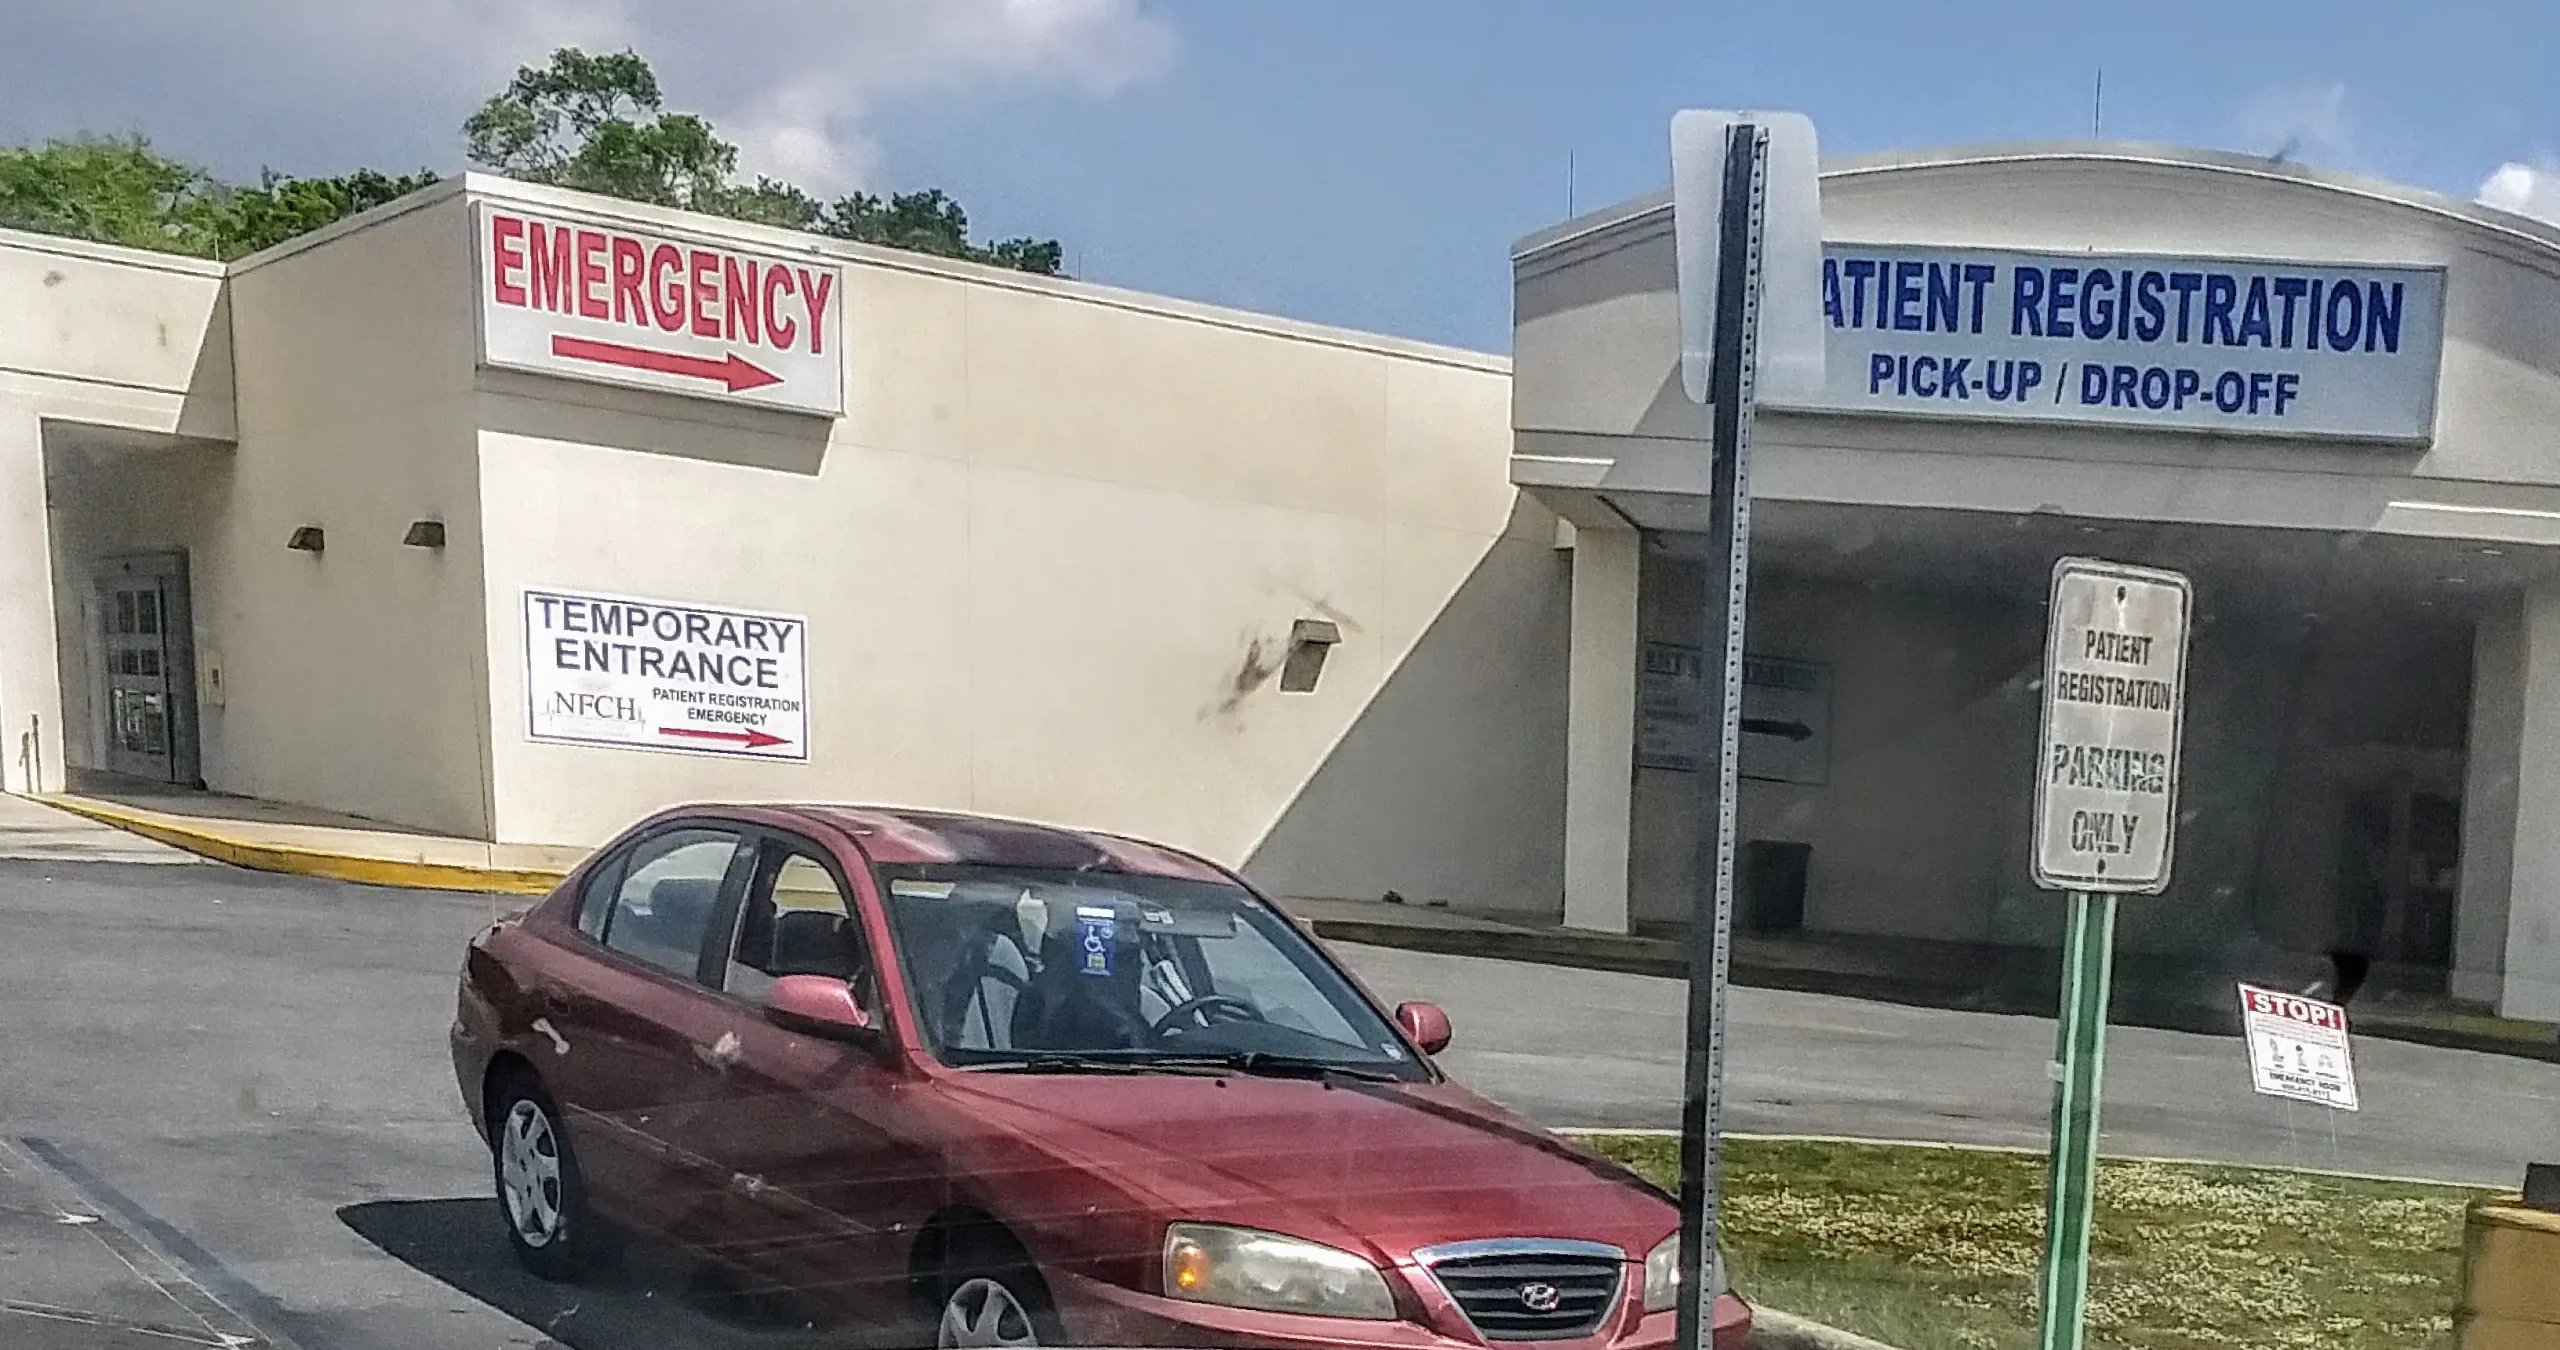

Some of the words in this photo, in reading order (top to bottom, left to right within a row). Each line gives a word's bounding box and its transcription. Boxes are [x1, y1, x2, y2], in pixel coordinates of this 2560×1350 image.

[493, 215, 834, 354] EMERGENCY
[1823, 258, 1996, 334] ATIENT
[2011, 266, 2405, 354] REGISTRATION
[1869, 353, 2042, 403] PICK-UP
[2054, 362, 2069, 404] /
[2081, 364, 2300, 416] DROP-OFF
[535, 597, 794, 653] TEMPORARY
[2084, 629, 2153, 666] PATIENT
[555, 637, 779, 689] ENTRANCE
[553, 691, 636, 722] NFCH
[652, 687, 705, 703] PATIENT
[708, 693, 800, 712] REGISTRATION
[2057, 670, 2172, 711] REGISTRATION
[687, 708, 768, 726] EMERGENCY
[2051, 743, 2165, 795] PARKING
[2070, 808, 2139, 854] ONLY
[2253, 992, 2337, 1029] STOP!
